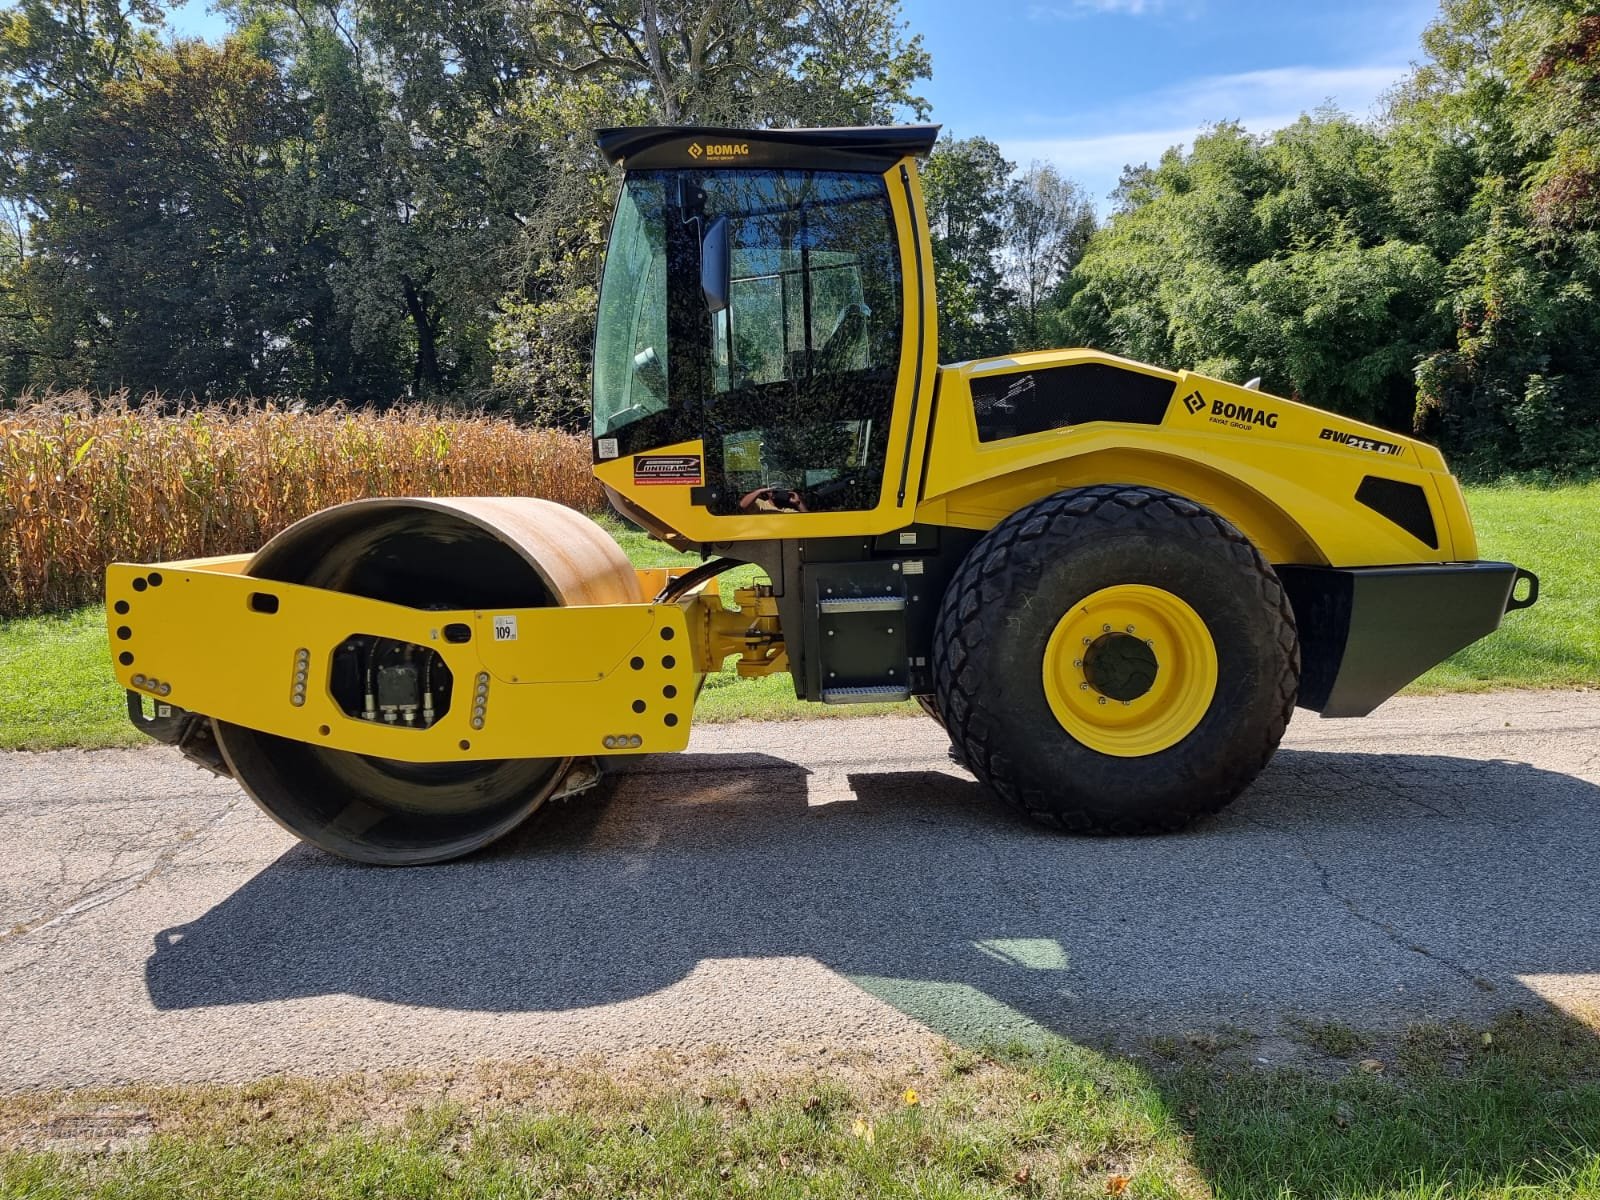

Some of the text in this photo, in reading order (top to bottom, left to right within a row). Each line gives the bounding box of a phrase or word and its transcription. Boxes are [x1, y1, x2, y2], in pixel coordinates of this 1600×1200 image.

[706, 144, 749, 155] BOMAG
[1211, 399, 1279, 429] BOMAG
[1208, 416, 1252, 431] FAYAT GROUP
[1319, 428, 1347, 444] BW
[1346, 438, 1375, 452] 213
[495, 626, 511, 640] 109
